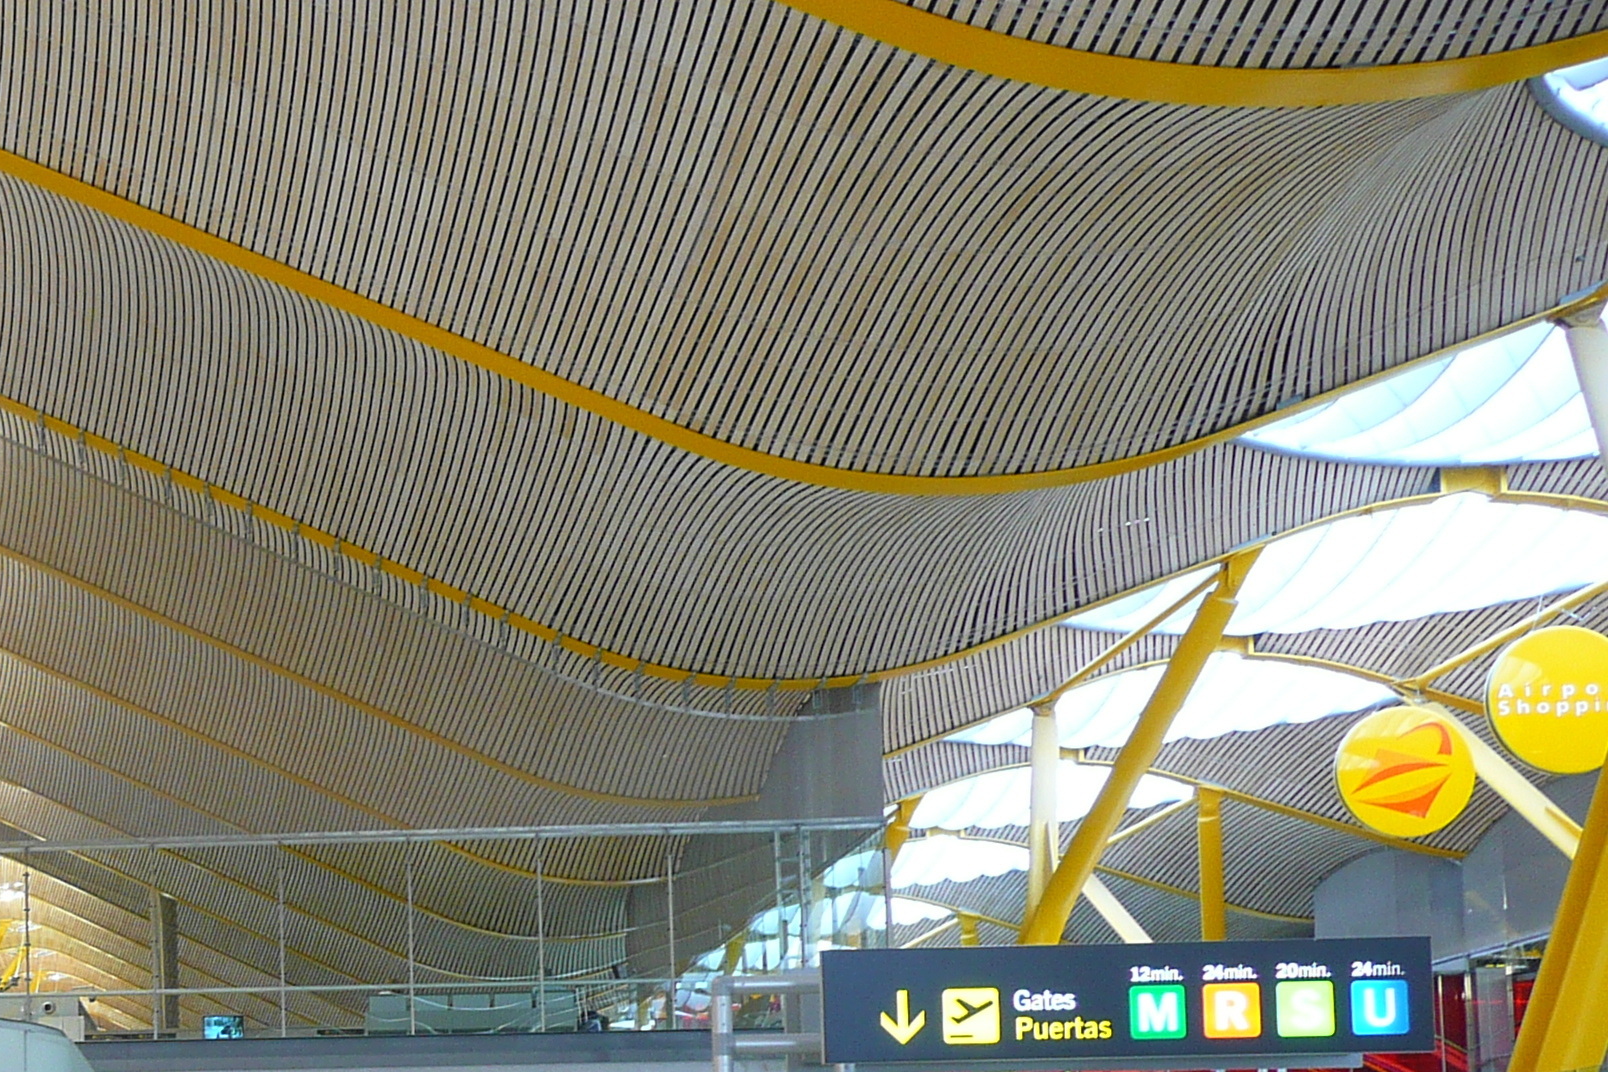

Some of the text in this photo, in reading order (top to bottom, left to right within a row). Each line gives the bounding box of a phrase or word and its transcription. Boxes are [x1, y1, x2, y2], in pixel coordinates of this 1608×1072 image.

[1498, 697, 1608, 717] Shoppi
[1130, 966, 1184, 983] 12min.
[1203, 963, 1258, 982] 24min.
[1275, 961, 1331, 980] 20min.
[1351, 961, 1405, 978] 24min.
[1013, 989, 1077, 1012] Gates
[1215, 991, 1250, 1031] R
[1291, 989, 1325, 1030] S
[1364, 988, 1396, 1028] U
[1138, 993, 1178, 1033] M
[1016, 1017, 1112, 1041] Puertas
